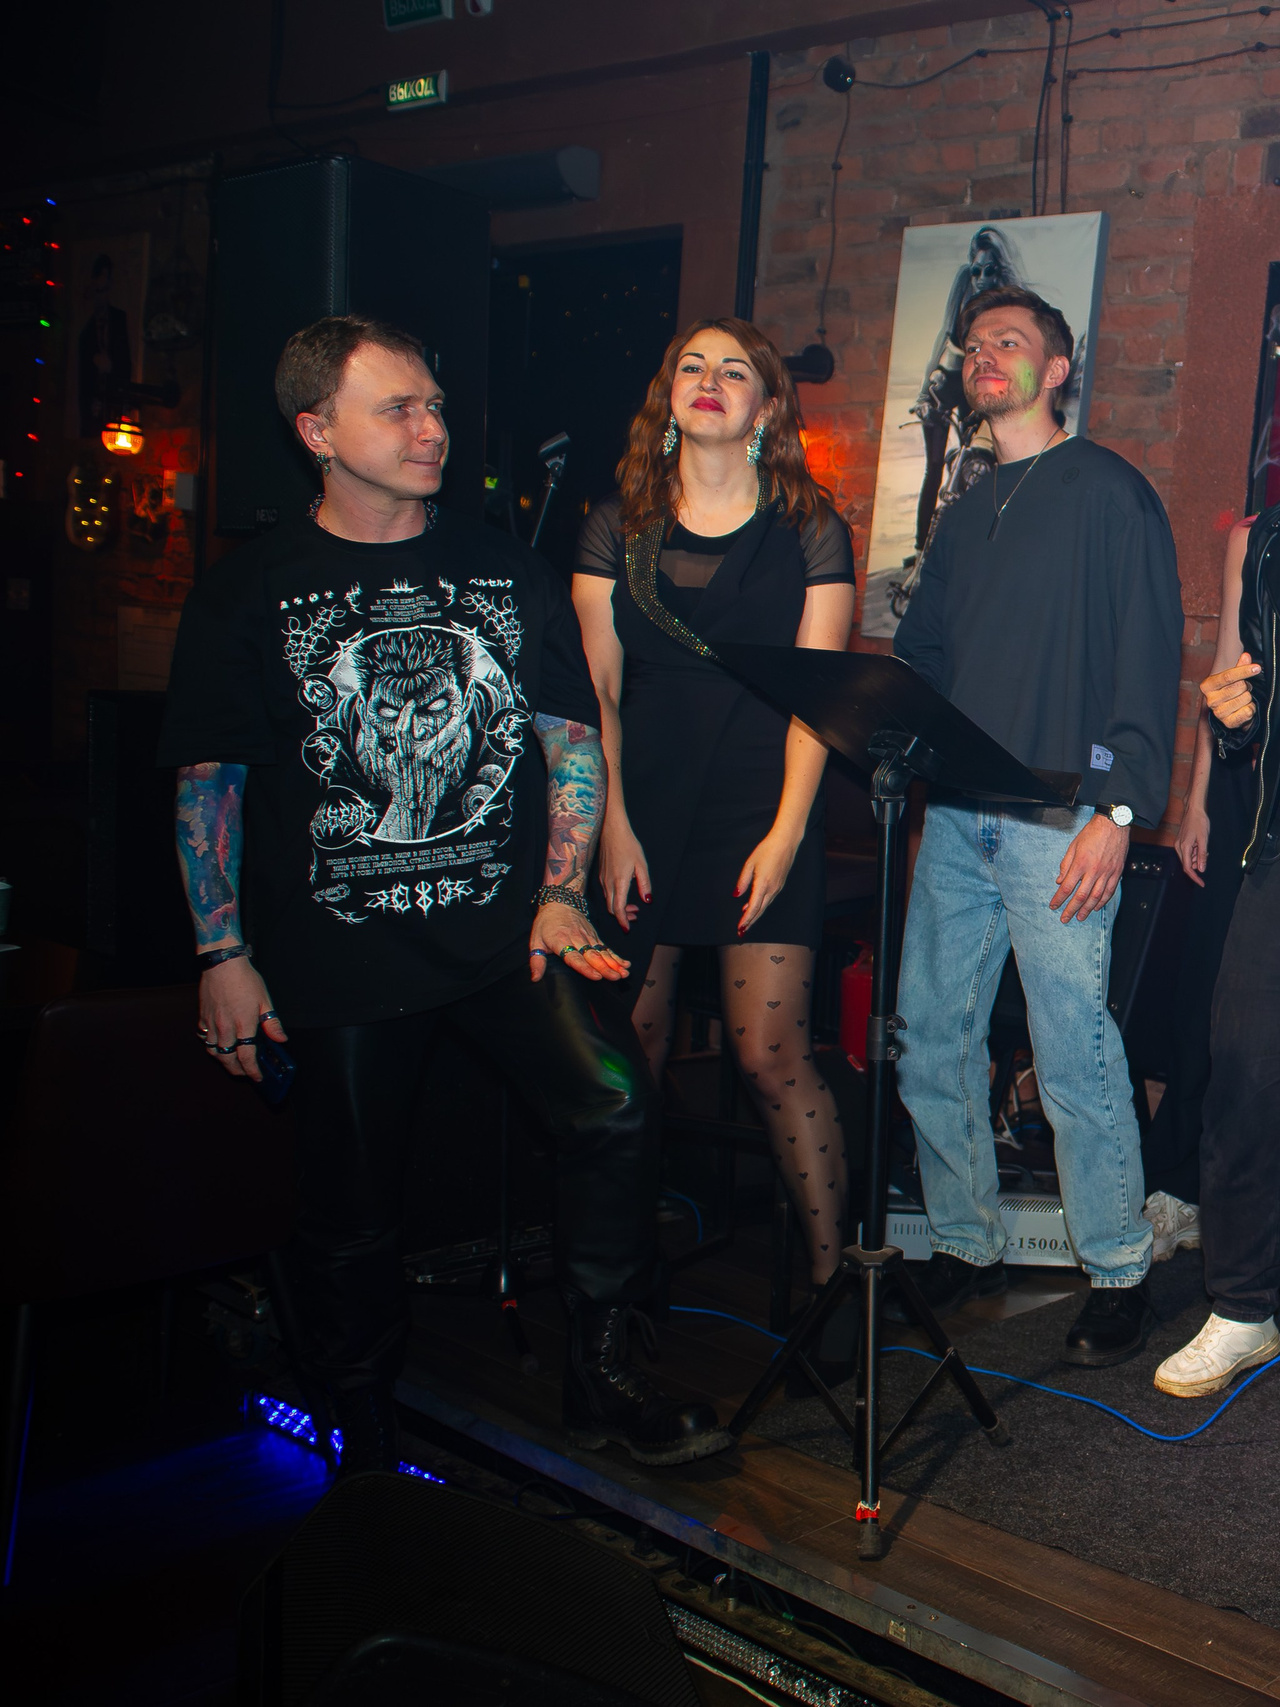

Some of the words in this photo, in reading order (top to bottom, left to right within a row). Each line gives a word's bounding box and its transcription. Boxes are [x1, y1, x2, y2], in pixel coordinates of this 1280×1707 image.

[389, 78, 435, 102] ВЫХОД
[468, 578, 514, 588] ベルセルク
